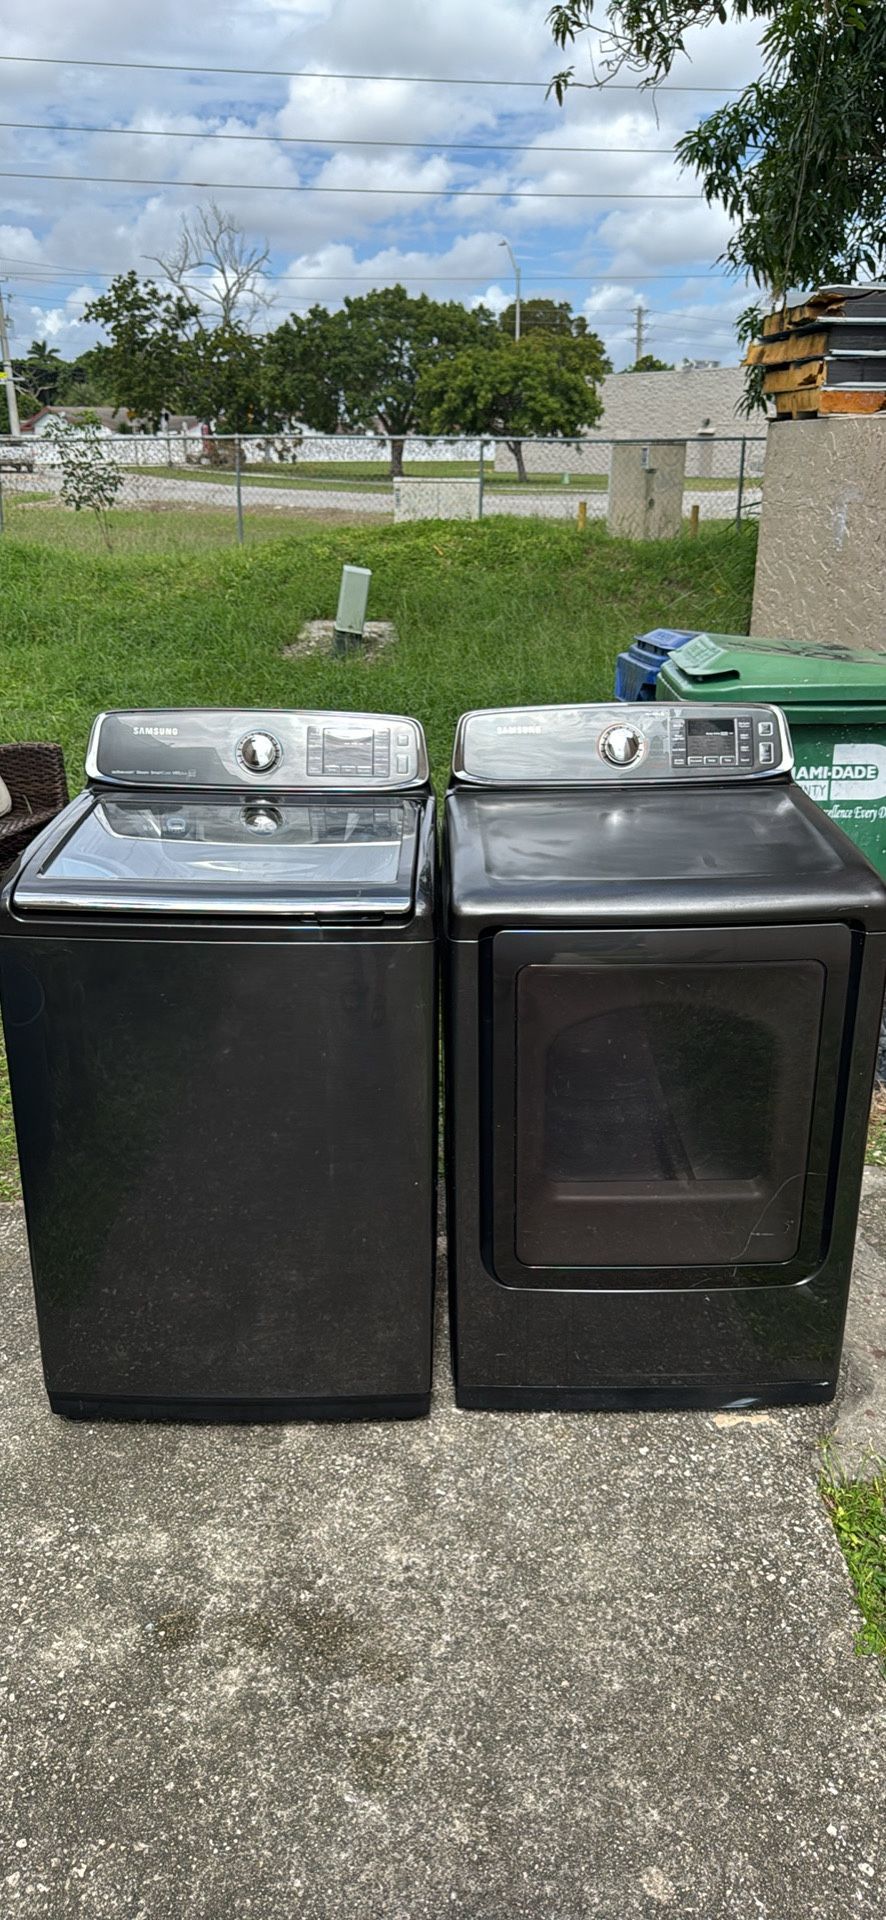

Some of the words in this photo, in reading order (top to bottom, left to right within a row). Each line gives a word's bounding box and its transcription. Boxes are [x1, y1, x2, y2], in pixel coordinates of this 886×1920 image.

[133, 727, 178, 736] SAMSUNG
[496, 725, 542, 735] SAMSUNG
[791, 766, 877, 780] IAMI-DADE
